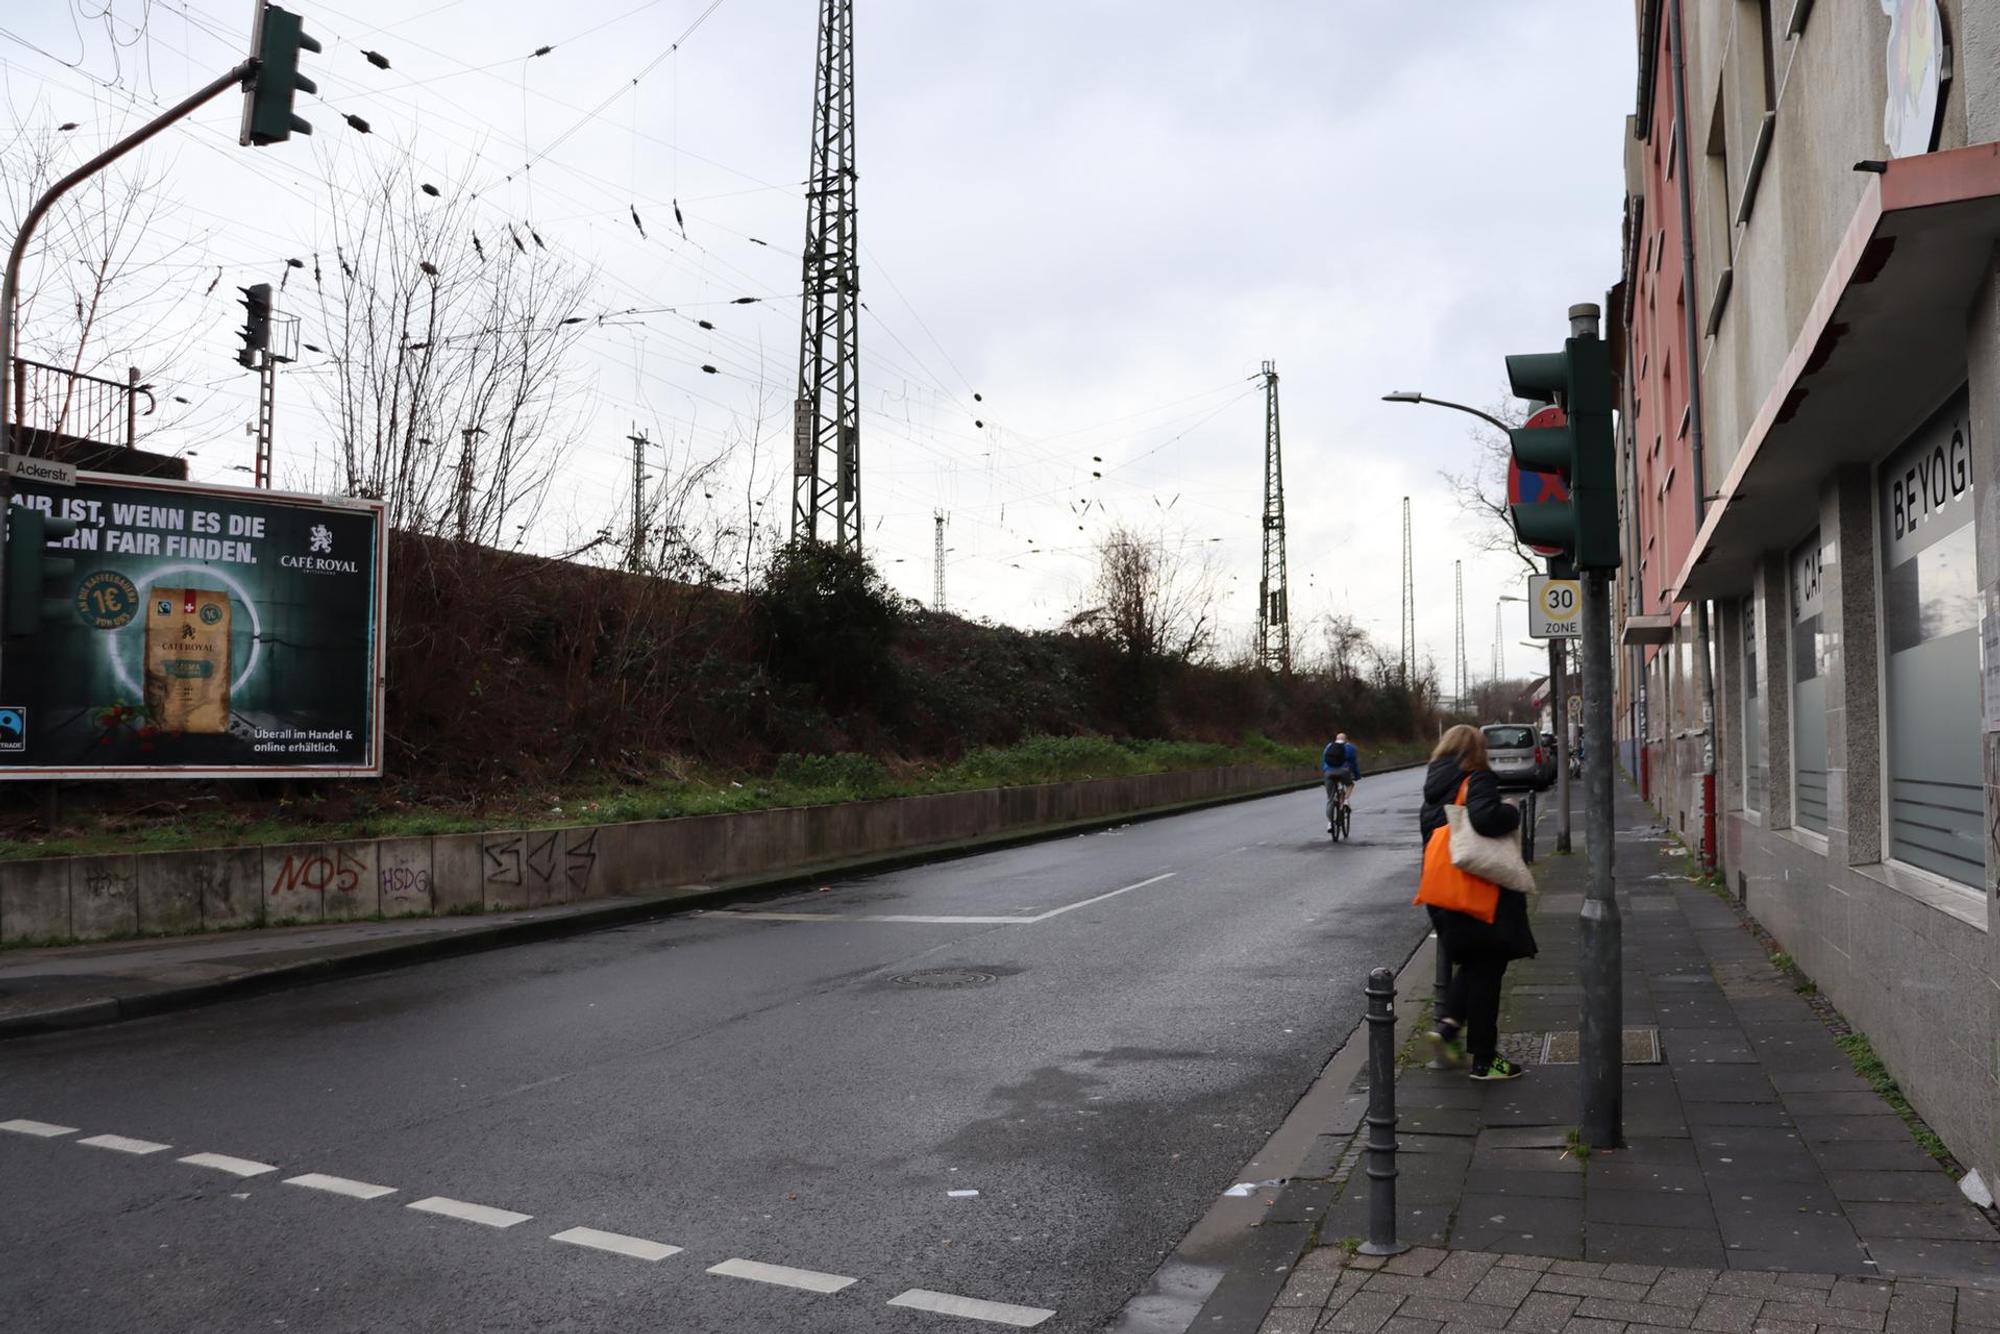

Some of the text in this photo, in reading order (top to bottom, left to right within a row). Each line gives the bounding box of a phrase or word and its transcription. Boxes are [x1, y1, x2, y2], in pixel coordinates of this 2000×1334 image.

[16, 460, 71, 482] Ackerstr.
[8, 493, 53, 518] AIR
[112, 503, 184, 530] WENN
[192, 511, 221, 534] ES
[229, 514, 266, 538] DIE
[106, 530, 160, 556] FAIR
[166, 535, 257, 564] FINDEN.
[316, 558, 358, 573] ROYAL
[1548, 589, 1572, 609] 30
[1545, 622, 1577, 633] ZONE
[254, 726, 353, 740] Überall im Handel &
[254, 741, 339, 753] online erhältlich.
